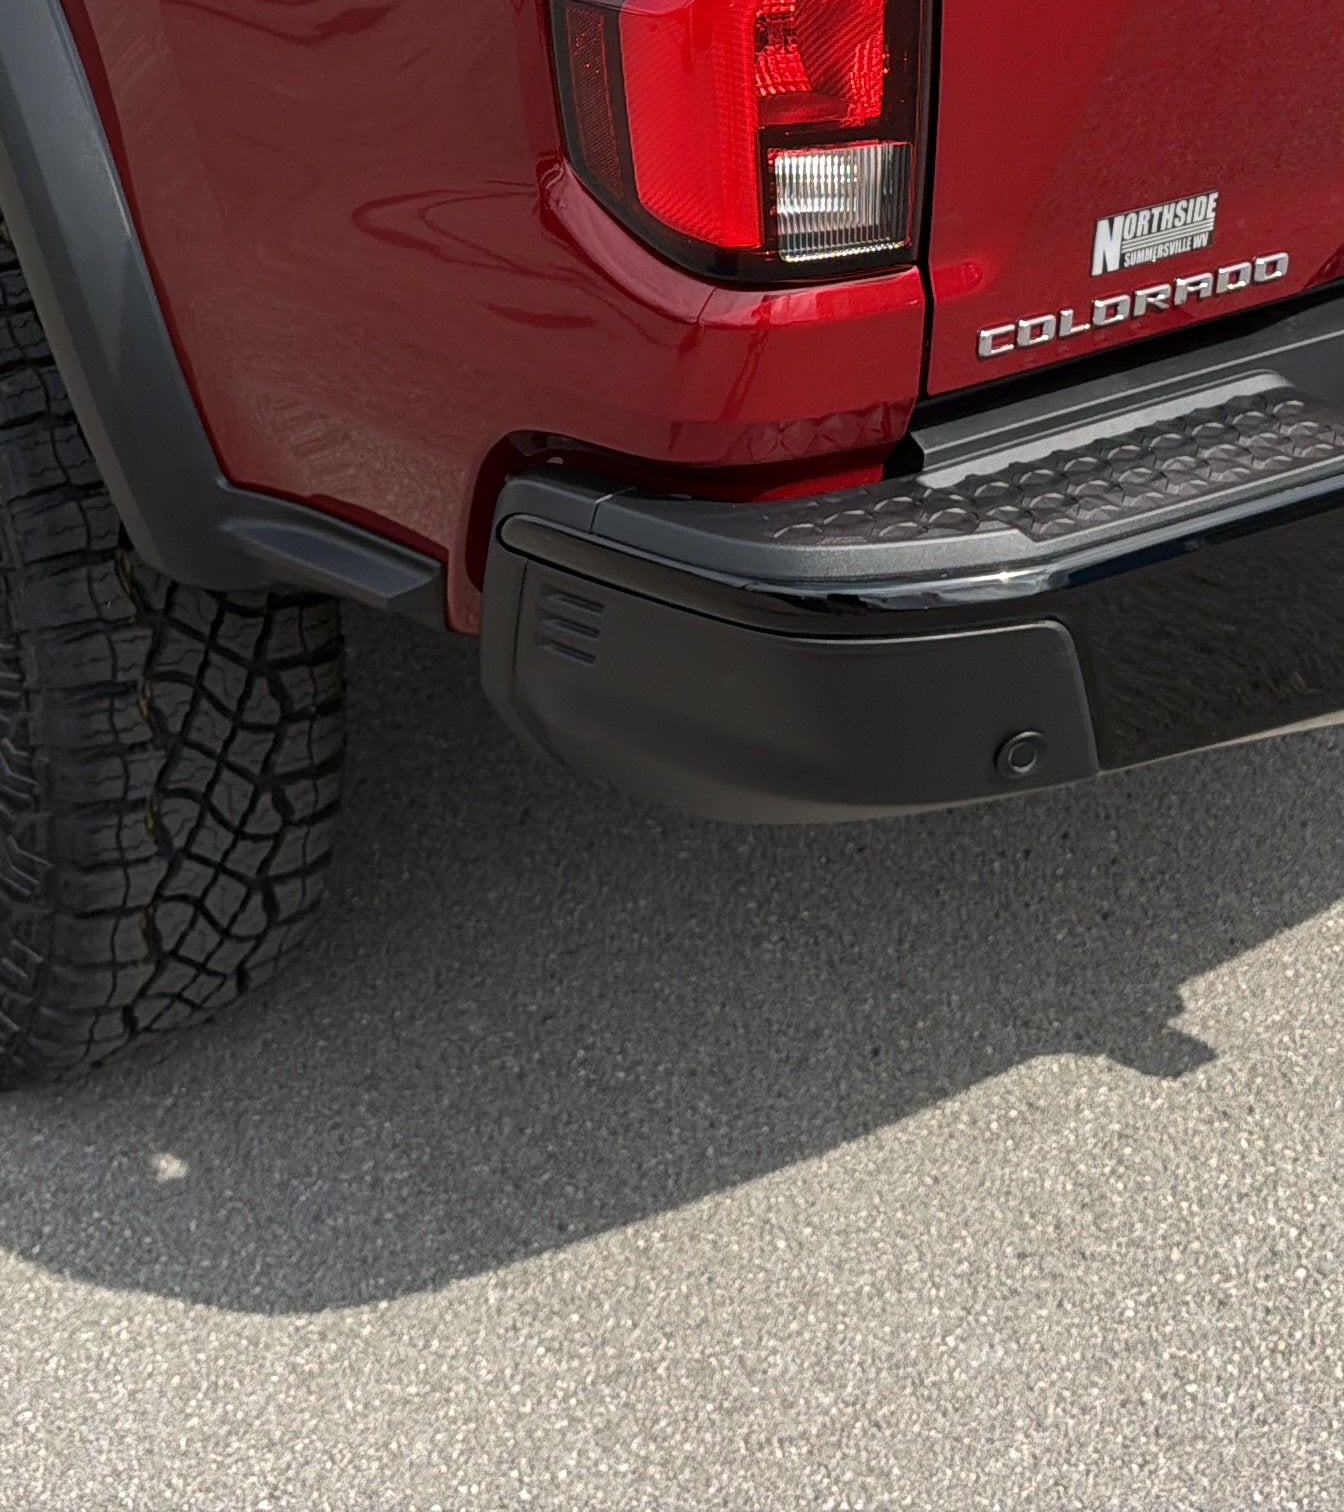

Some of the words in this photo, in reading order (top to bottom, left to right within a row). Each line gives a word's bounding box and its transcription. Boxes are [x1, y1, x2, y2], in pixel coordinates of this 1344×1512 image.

[1091, 191, 1219, 276] NORTHSIDE
[1123, 236, 1192, 268] SUMMERSVILLE
[1192, 231, 1210, 249] WV
[977, 251, 1289, 357] COLORADO
